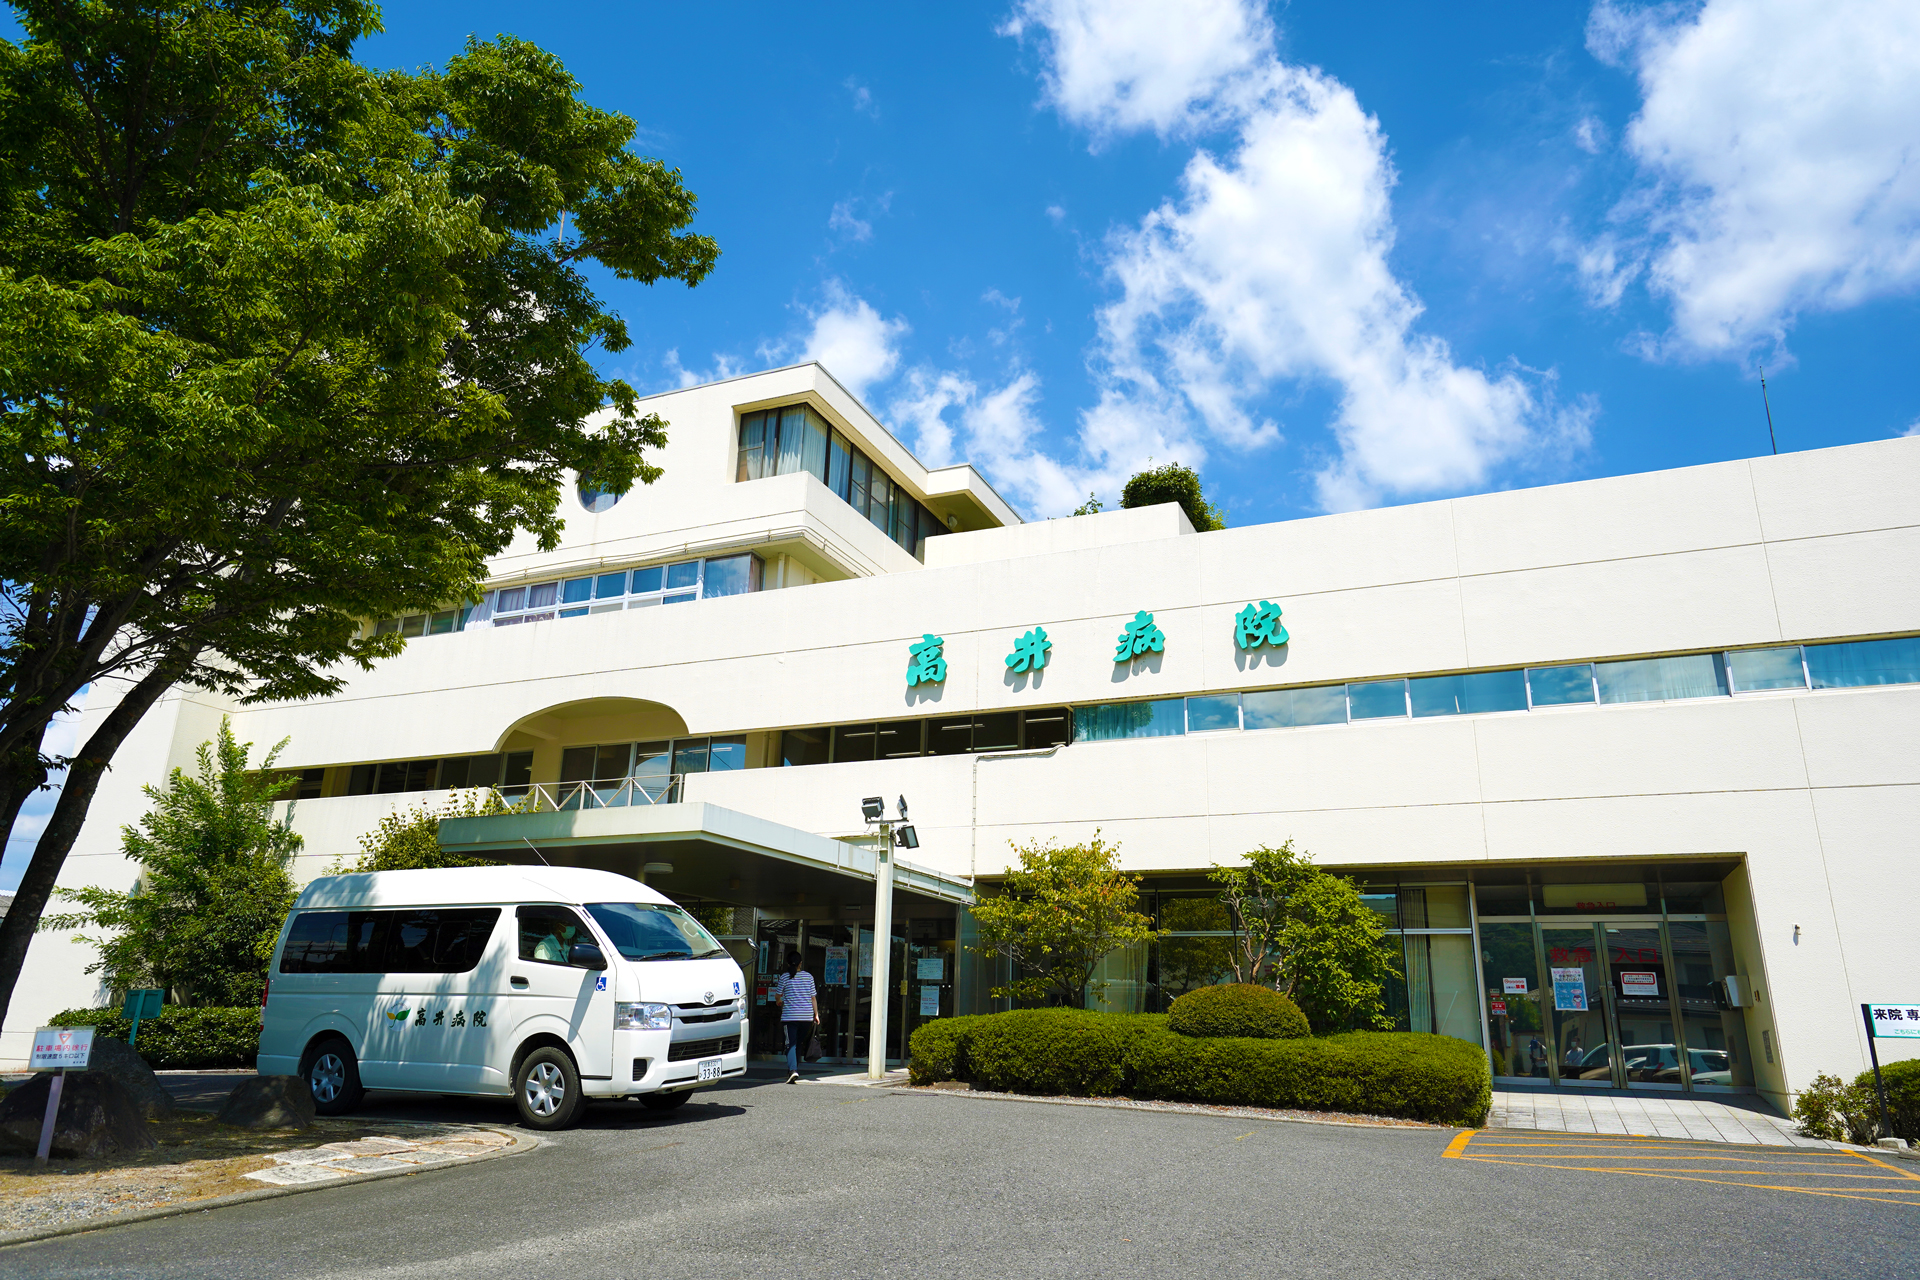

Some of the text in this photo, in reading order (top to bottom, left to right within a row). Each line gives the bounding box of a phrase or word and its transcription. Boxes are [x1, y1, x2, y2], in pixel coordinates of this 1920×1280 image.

[906, 600, 1290, 687] 高井病院
[1549, 947, 1658, 963] 救急 入口
[415, 1007, 487, 1027] 高井病院
[36, 1044, 88, 1052] 駐車場内徐行
